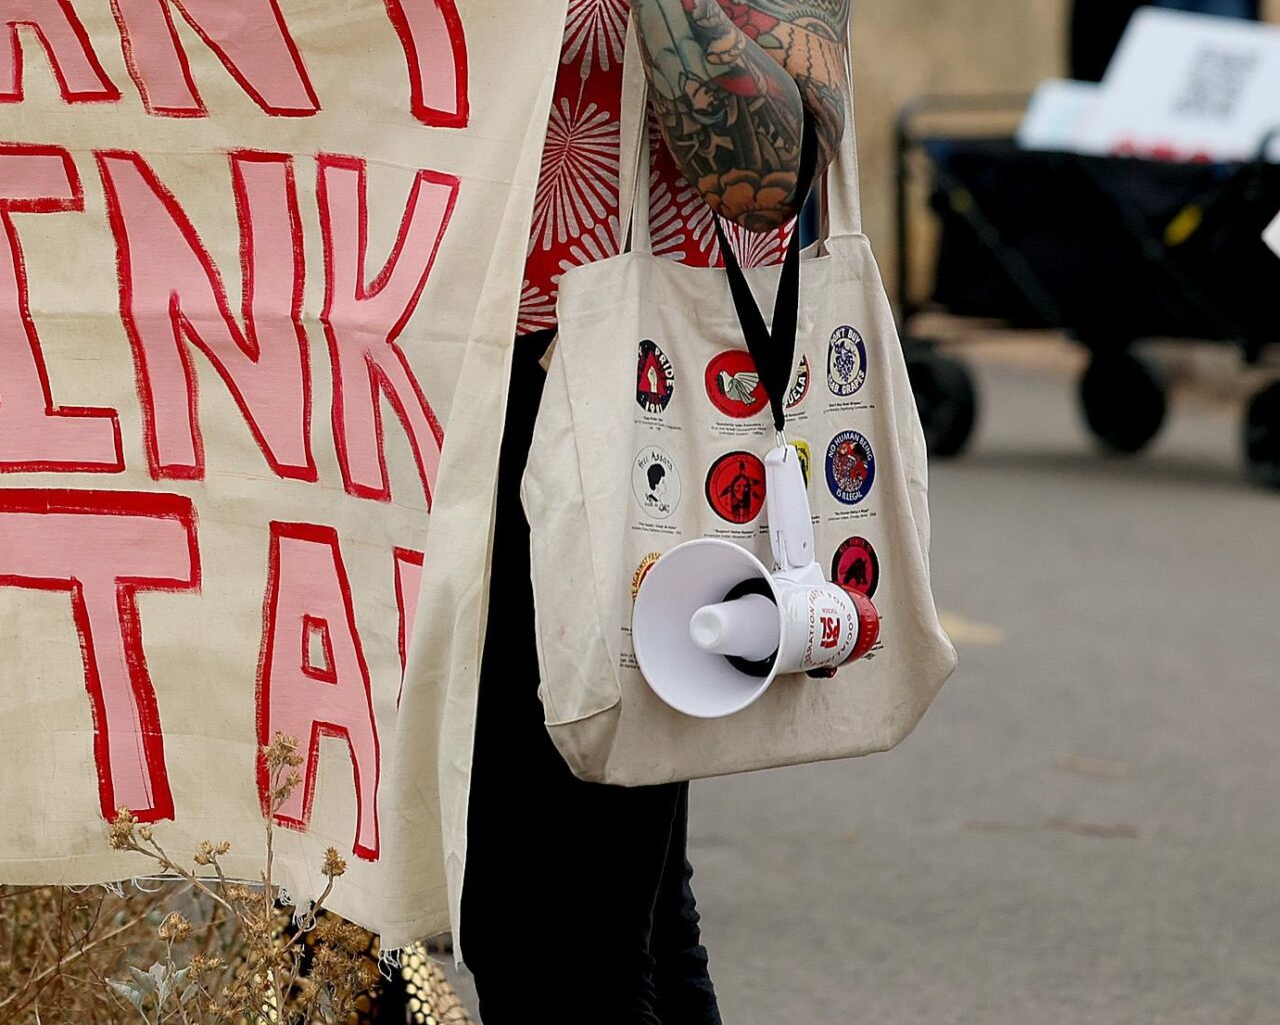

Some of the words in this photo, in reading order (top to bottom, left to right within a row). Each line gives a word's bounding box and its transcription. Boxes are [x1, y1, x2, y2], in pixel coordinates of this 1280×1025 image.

[654, 346, 675, 387] PRIDE
[828, 445, 836, 458] NO
[835, 432, 860, 446] HUMAN
[859, 438, 873, 461] BEING
